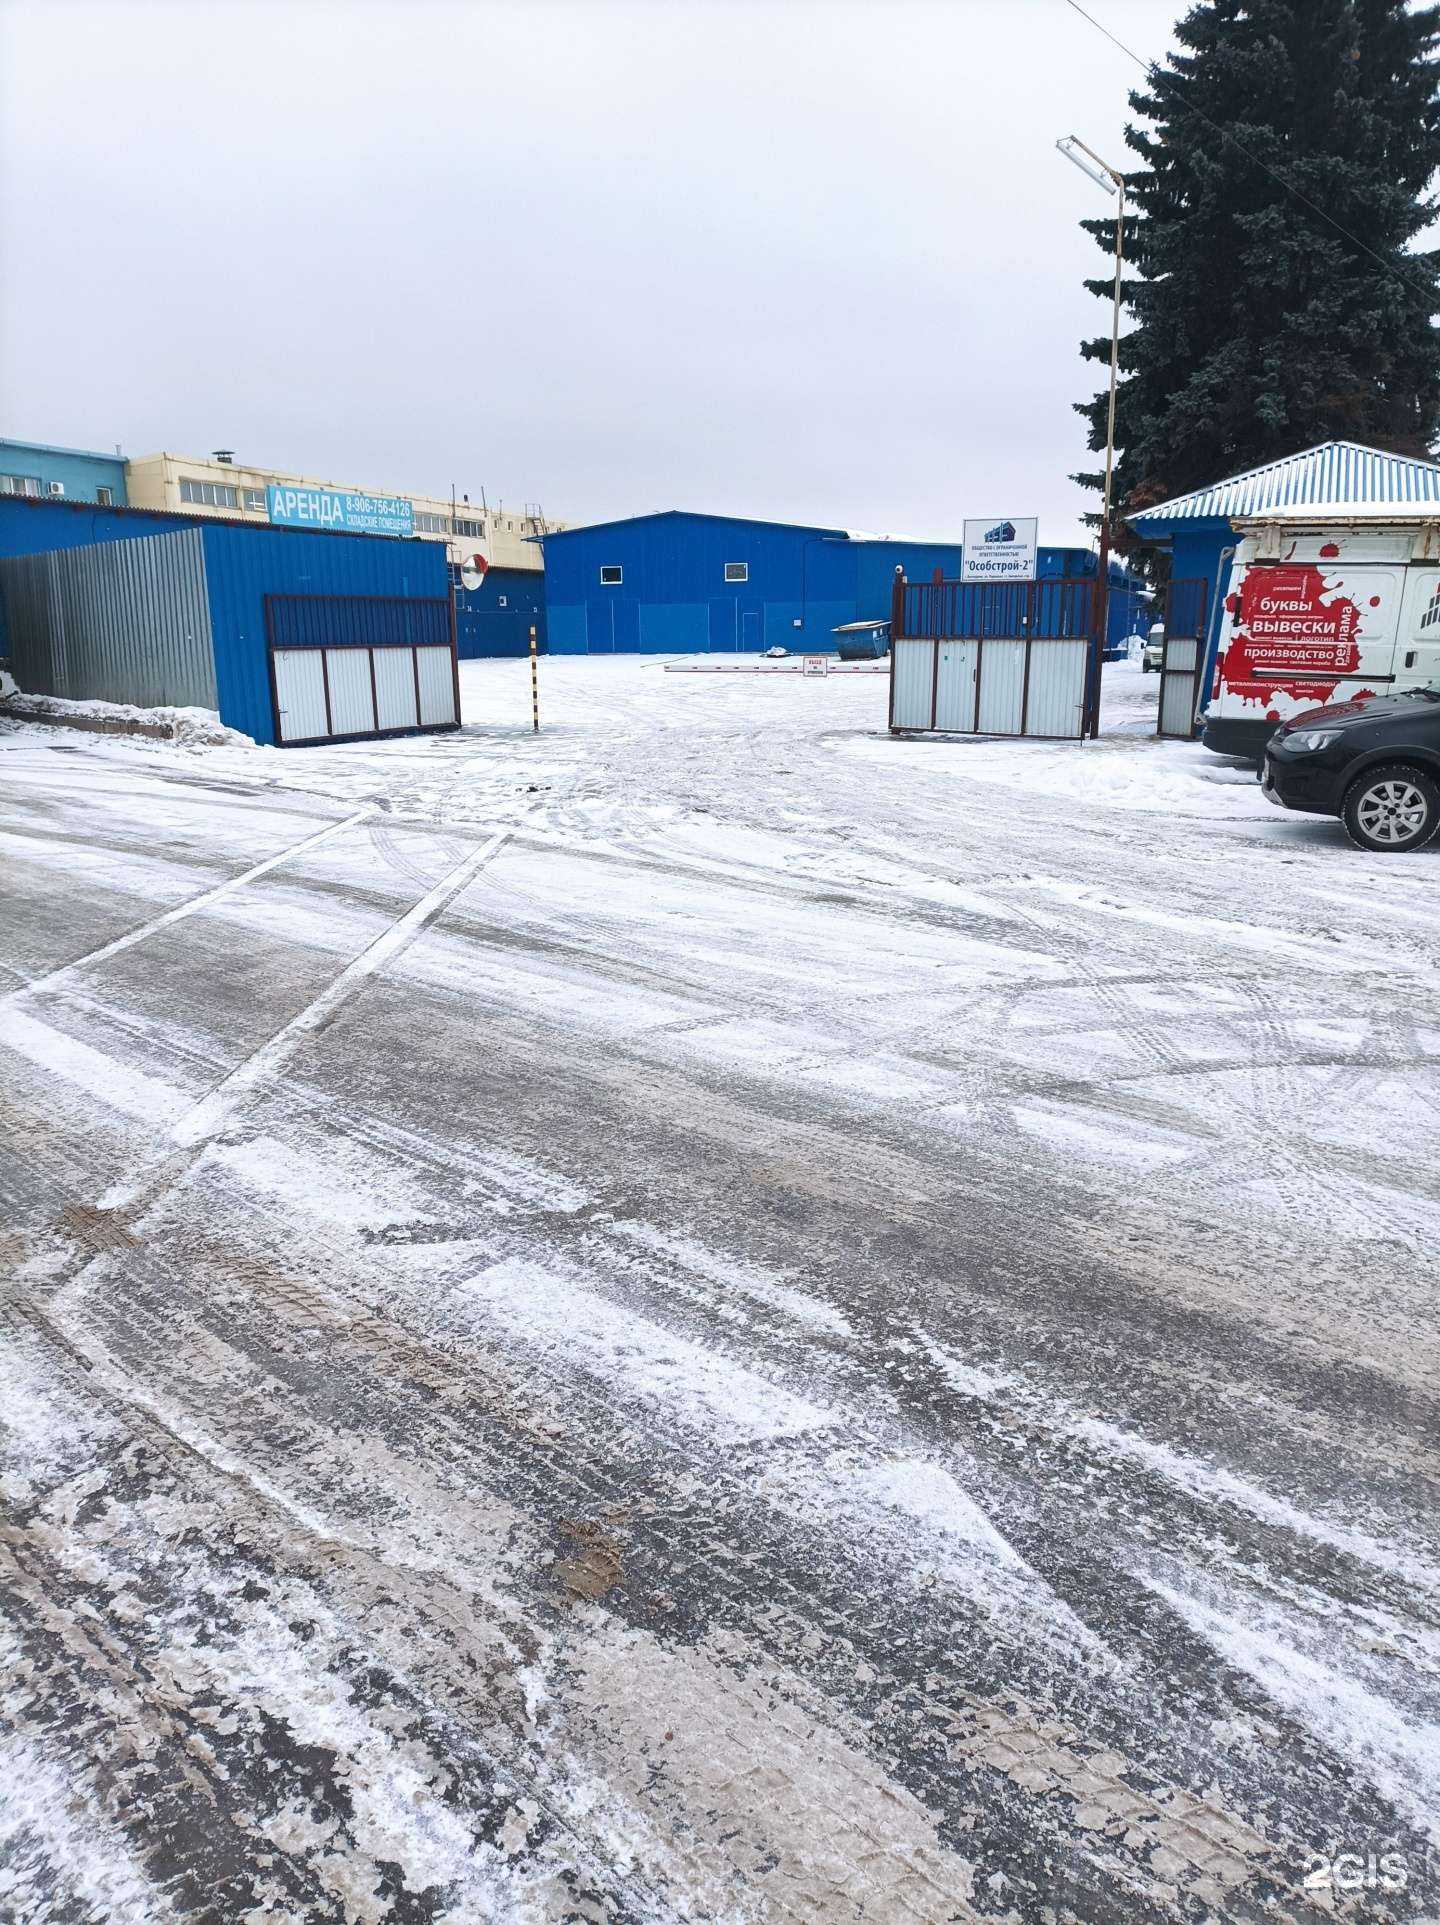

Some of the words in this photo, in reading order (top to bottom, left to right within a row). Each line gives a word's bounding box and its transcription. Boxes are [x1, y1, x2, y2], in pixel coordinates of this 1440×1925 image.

[273, 490, 344, 526] АРЕНДА
[346, 496, 410, 517] 8-906-756-4126
[346, 514, 378, 528] СКЛАДСКИЕ
[965, 559, 1033, 573] "Особстрой-2"
[1260, 596, 1313, 614] буквы
[1252, 620, 1336, 634] вывески
[1334, 605, 1353, 667] реклама
[1243, 648, 1335, 660] производство
